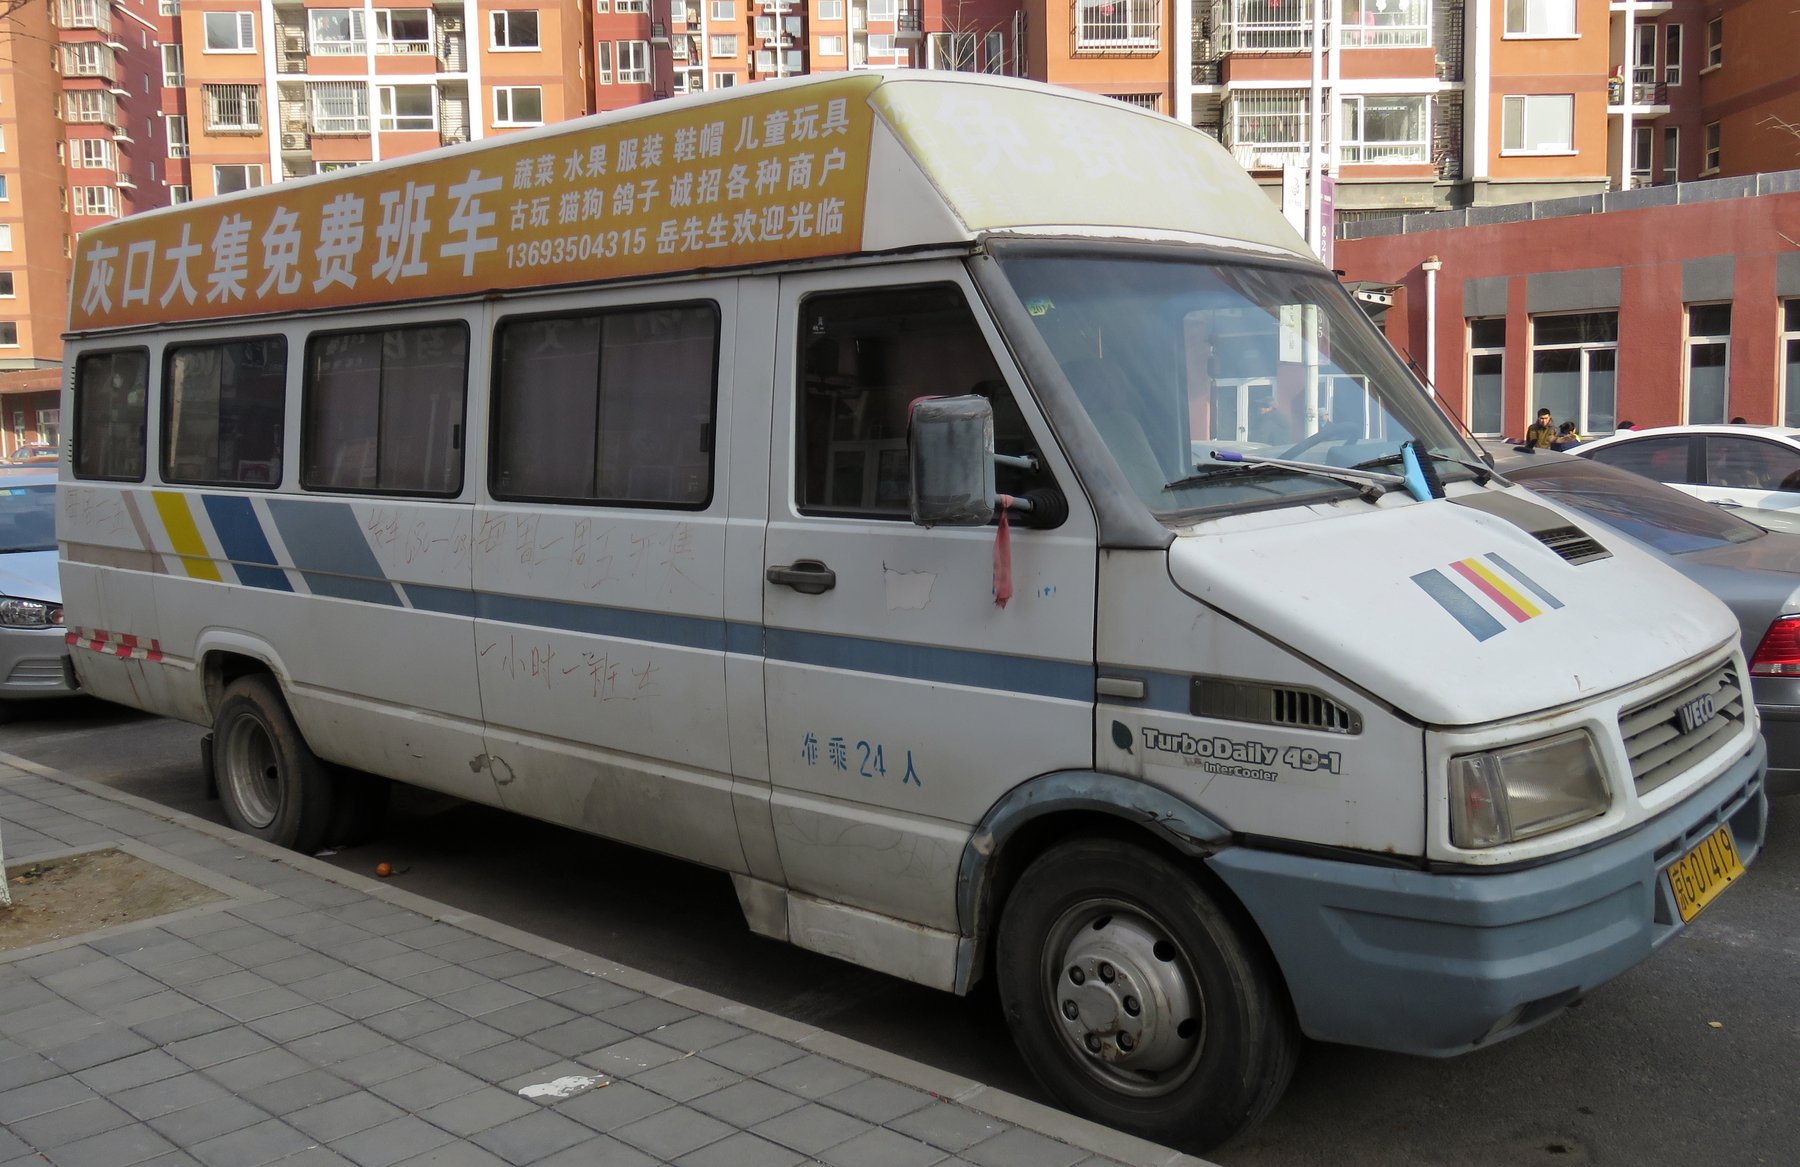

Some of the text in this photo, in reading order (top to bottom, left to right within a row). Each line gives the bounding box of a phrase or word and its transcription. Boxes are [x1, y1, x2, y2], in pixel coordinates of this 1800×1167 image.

[513, 98, 849, 190] 蔬菜 水果 服装 鞋帽 儿童玩具
[510, 147, 846, 231] 古玩 猫狗 鸽子 诚招各种商户
[81, 169, 503, 316] 灰口大集免费班车
[506, 197, 845, 269] 13693504315 岳先生欢迎光临
[1142, 727, 1278, 765] TurboDaily
[1204, 761, 1279, 782] InterCooler
